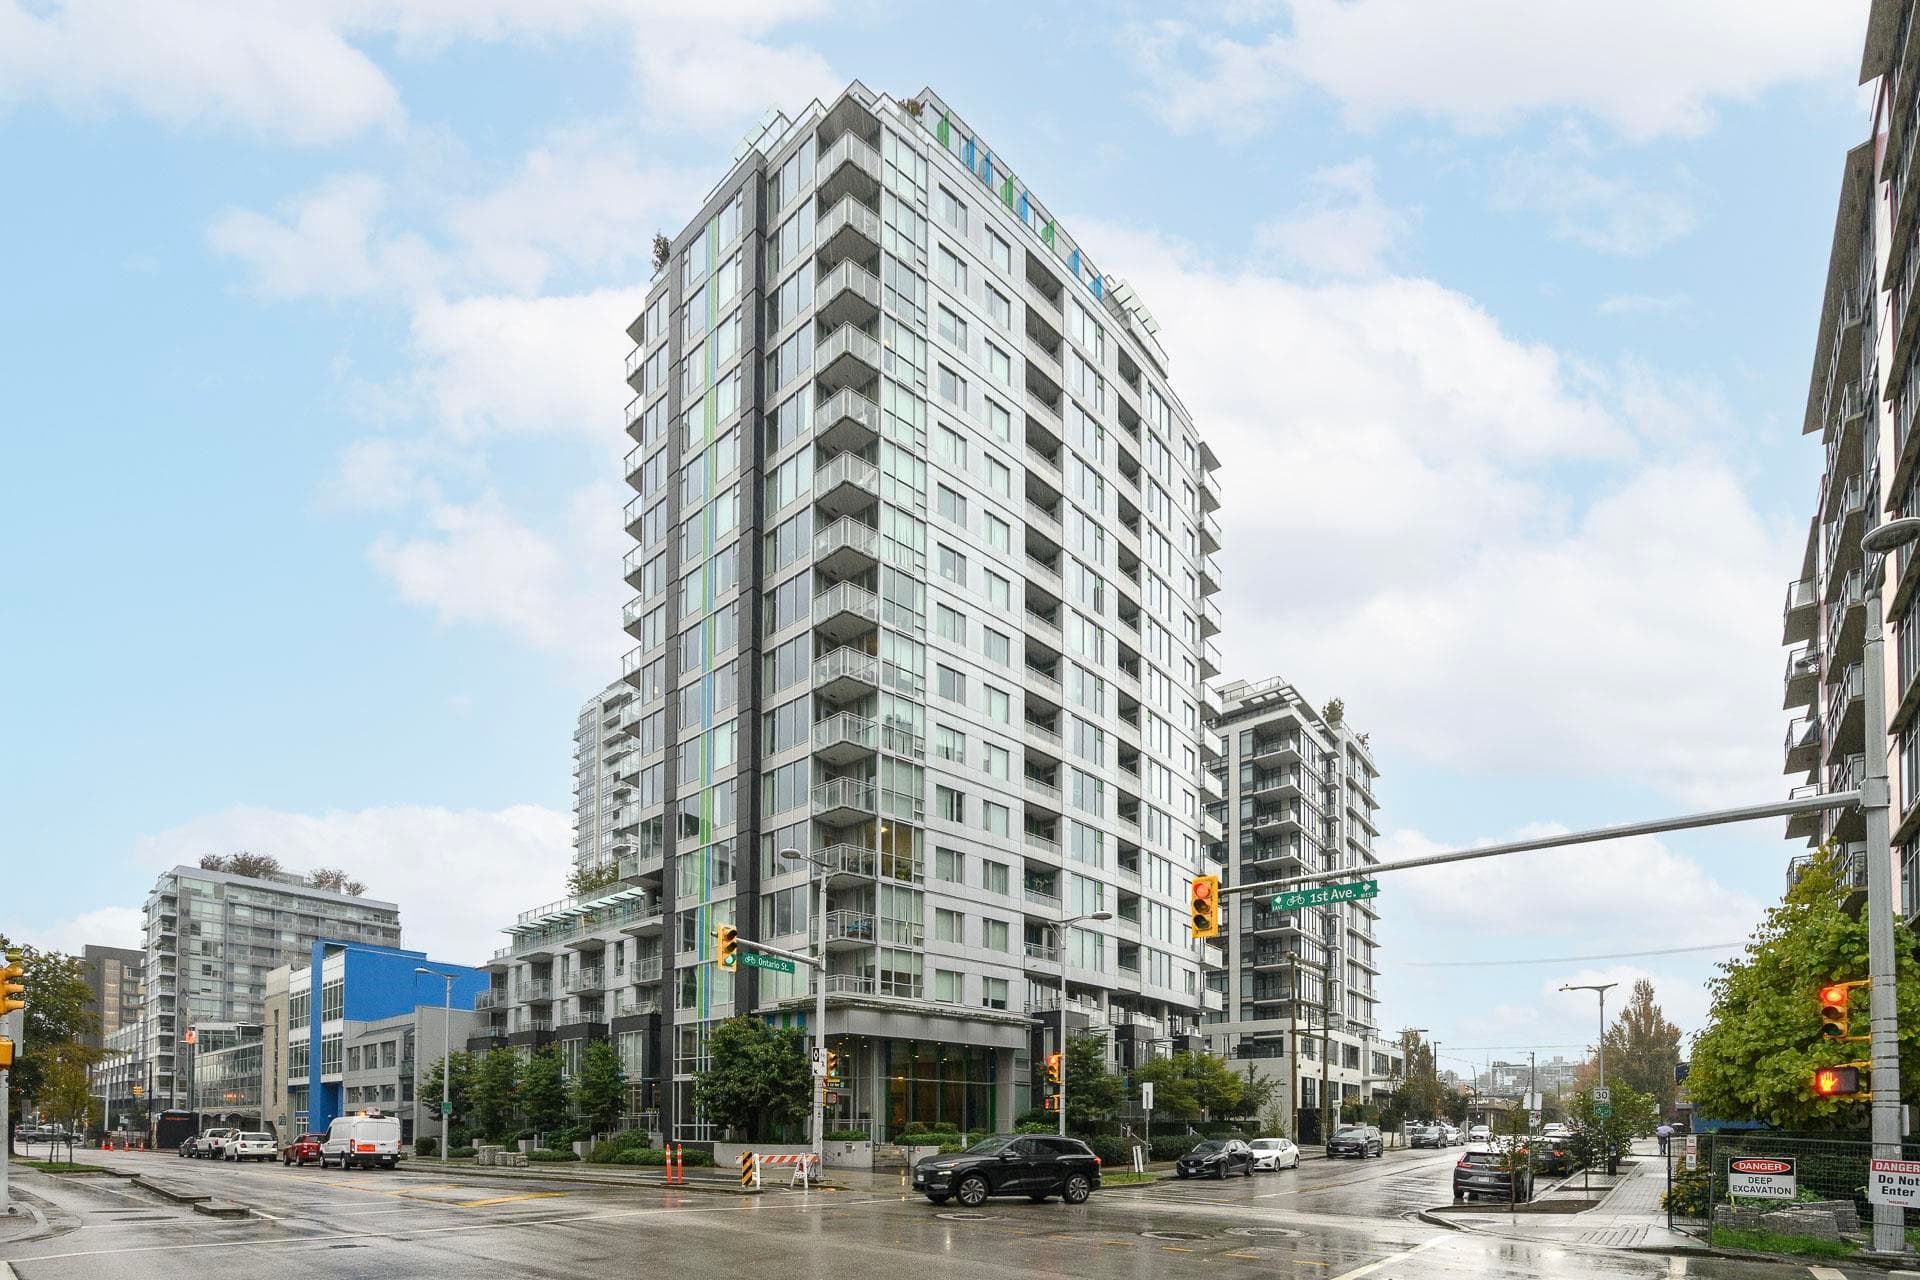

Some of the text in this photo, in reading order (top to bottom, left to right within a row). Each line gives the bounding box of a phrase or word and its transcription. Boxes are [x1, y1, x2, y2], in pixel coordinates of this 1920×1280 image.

[1310, 889, 1356, 903] 1st Ave.
[758, 958, 789, 971] Ontario St.
[1596, 1091, 1608, 1100] 30
[1739, 1162, 1782, 1171] DANGER
[1875, 1162, 1920, 1173] DANGER
[1878, 1175, 1920, 1186] Do Not
[1732, 1185, 1792, 1195] EXCAVATION
[1881, 1186, 1915, 1197] Enter
